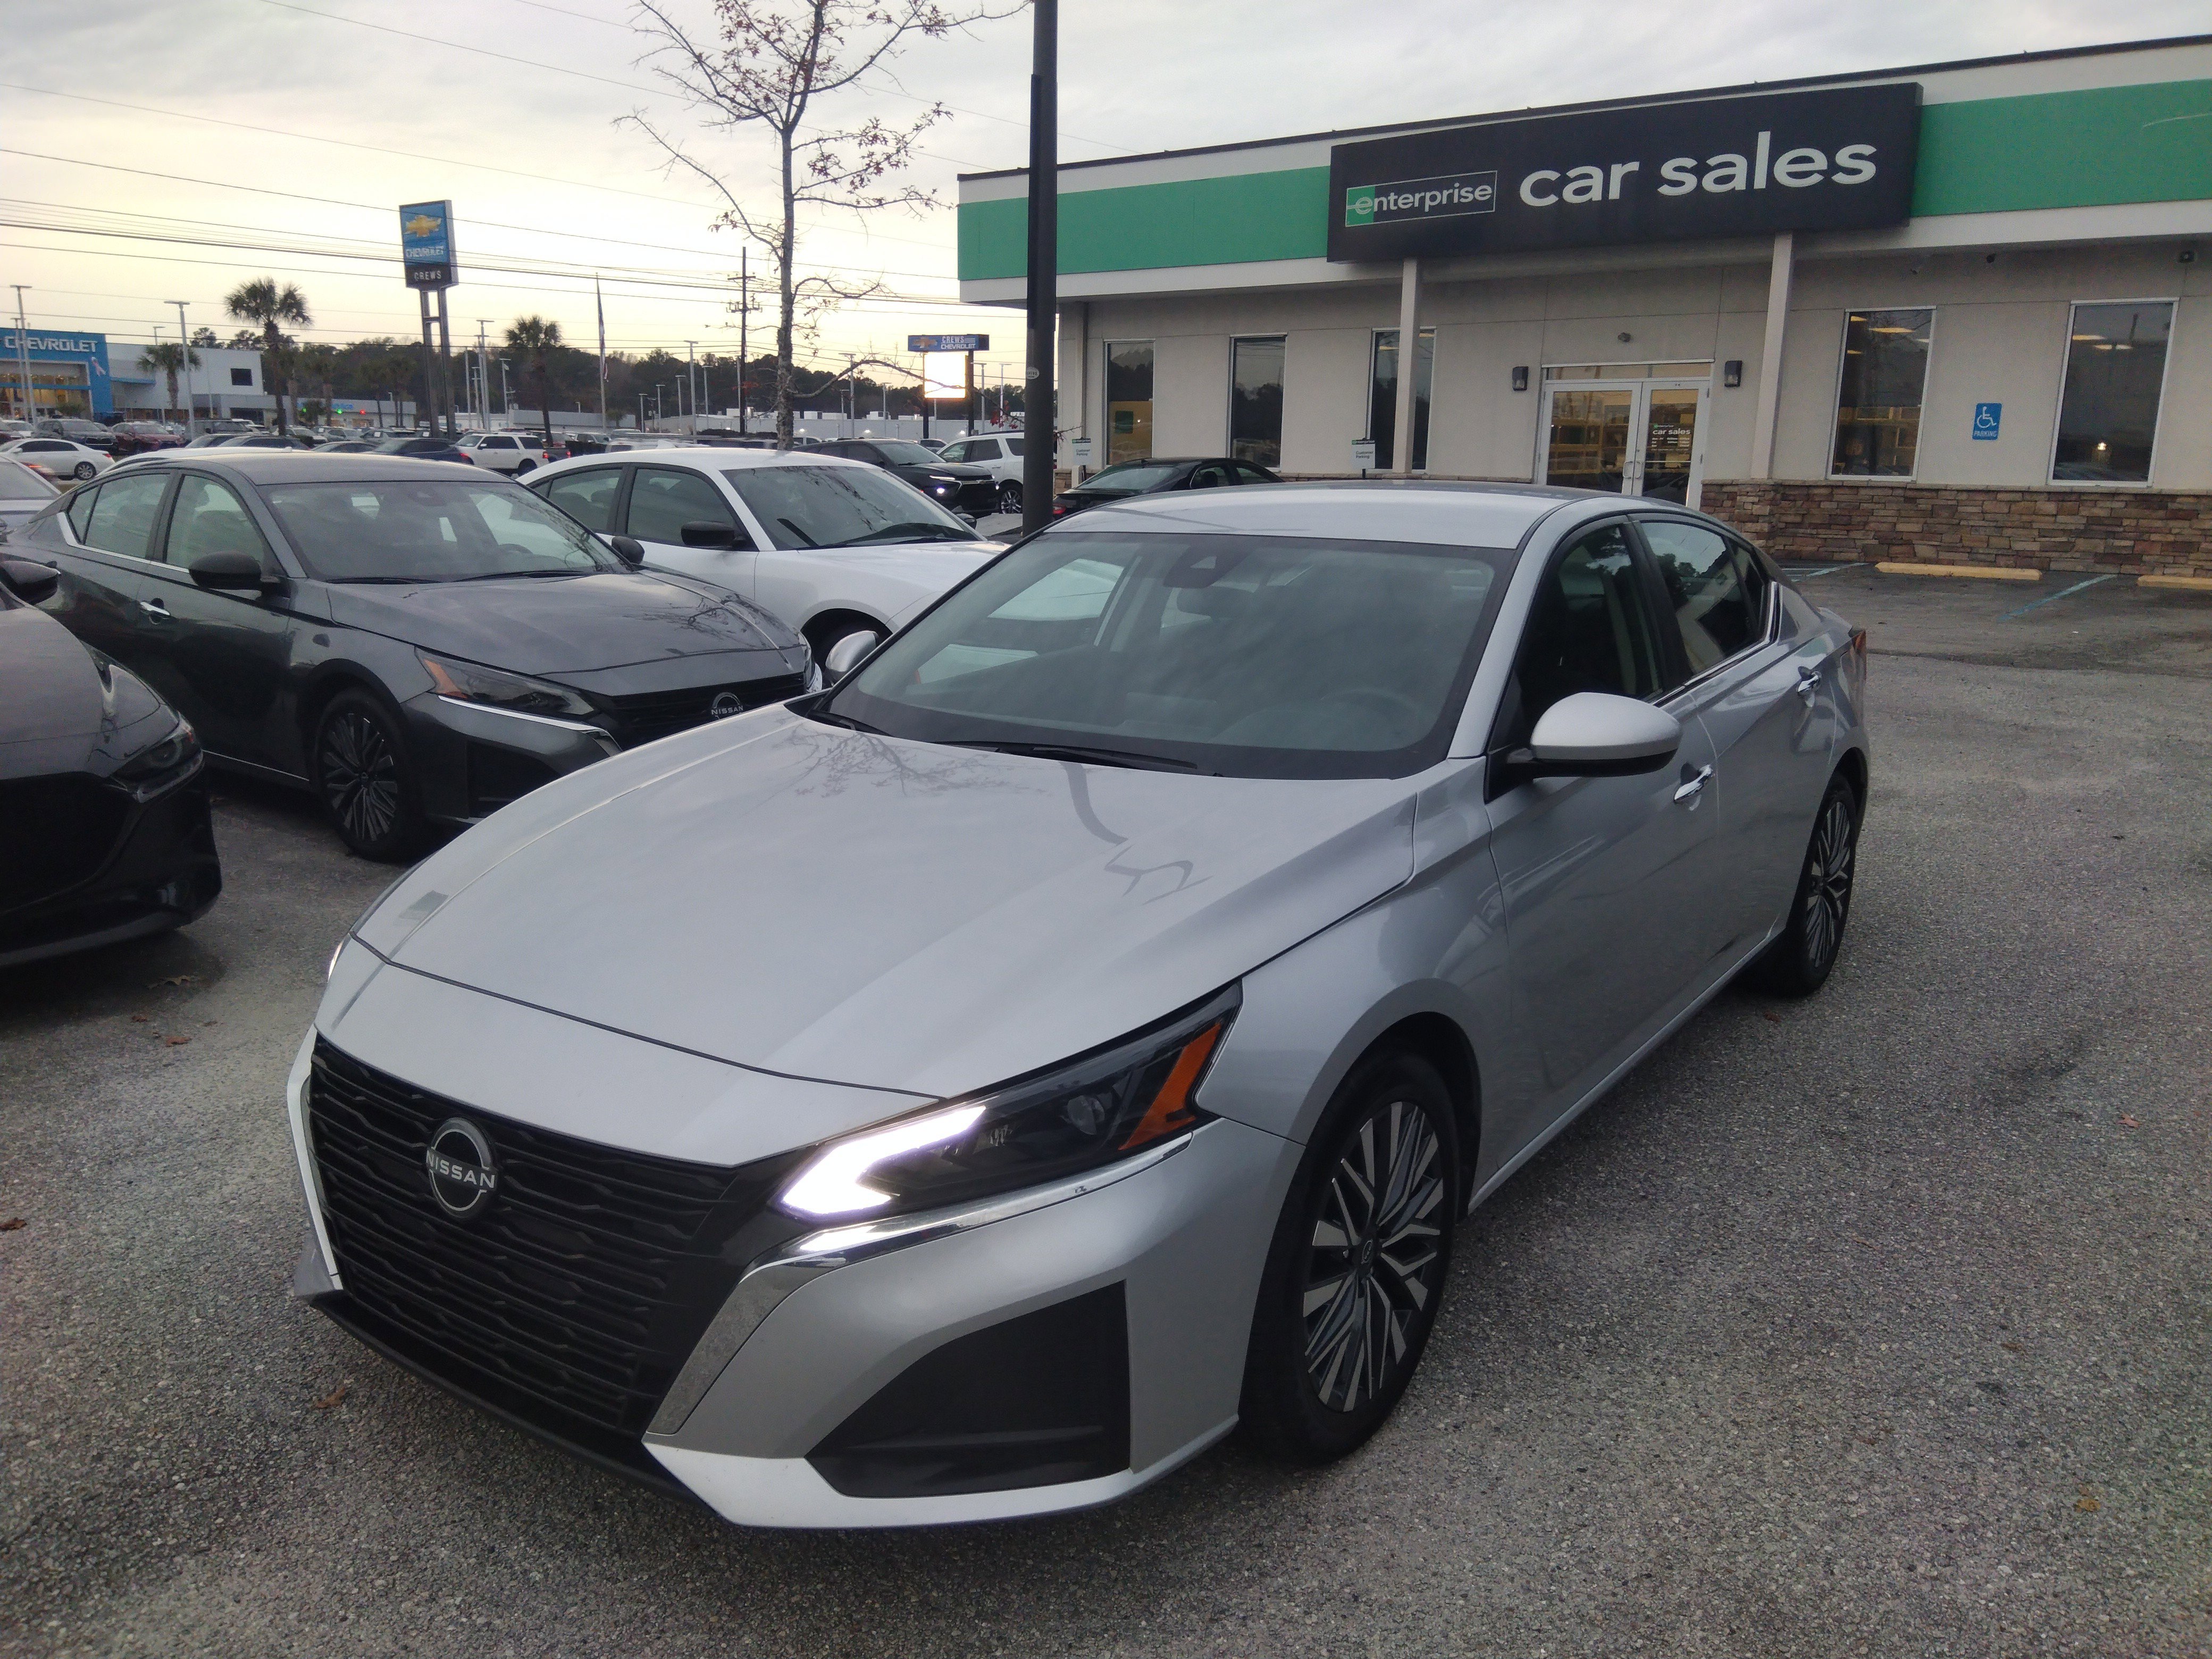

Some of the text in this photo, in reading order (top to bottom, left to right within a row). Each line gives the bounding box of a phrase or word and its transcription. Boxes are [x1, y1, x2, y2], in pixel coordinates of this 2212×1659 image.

[1519, 130, 1878, 207] car sales
[1355, 182, 1492, 214] enterprise
[406, 246, 444, 257] CHEVROLET
[414, 270, 441, 281] CREWS
[4, 336, 97, 353] CHEVROLET
[711, 705, 744, 715] NISSAN
[426, 1149, 496, 1188] NISSAN
